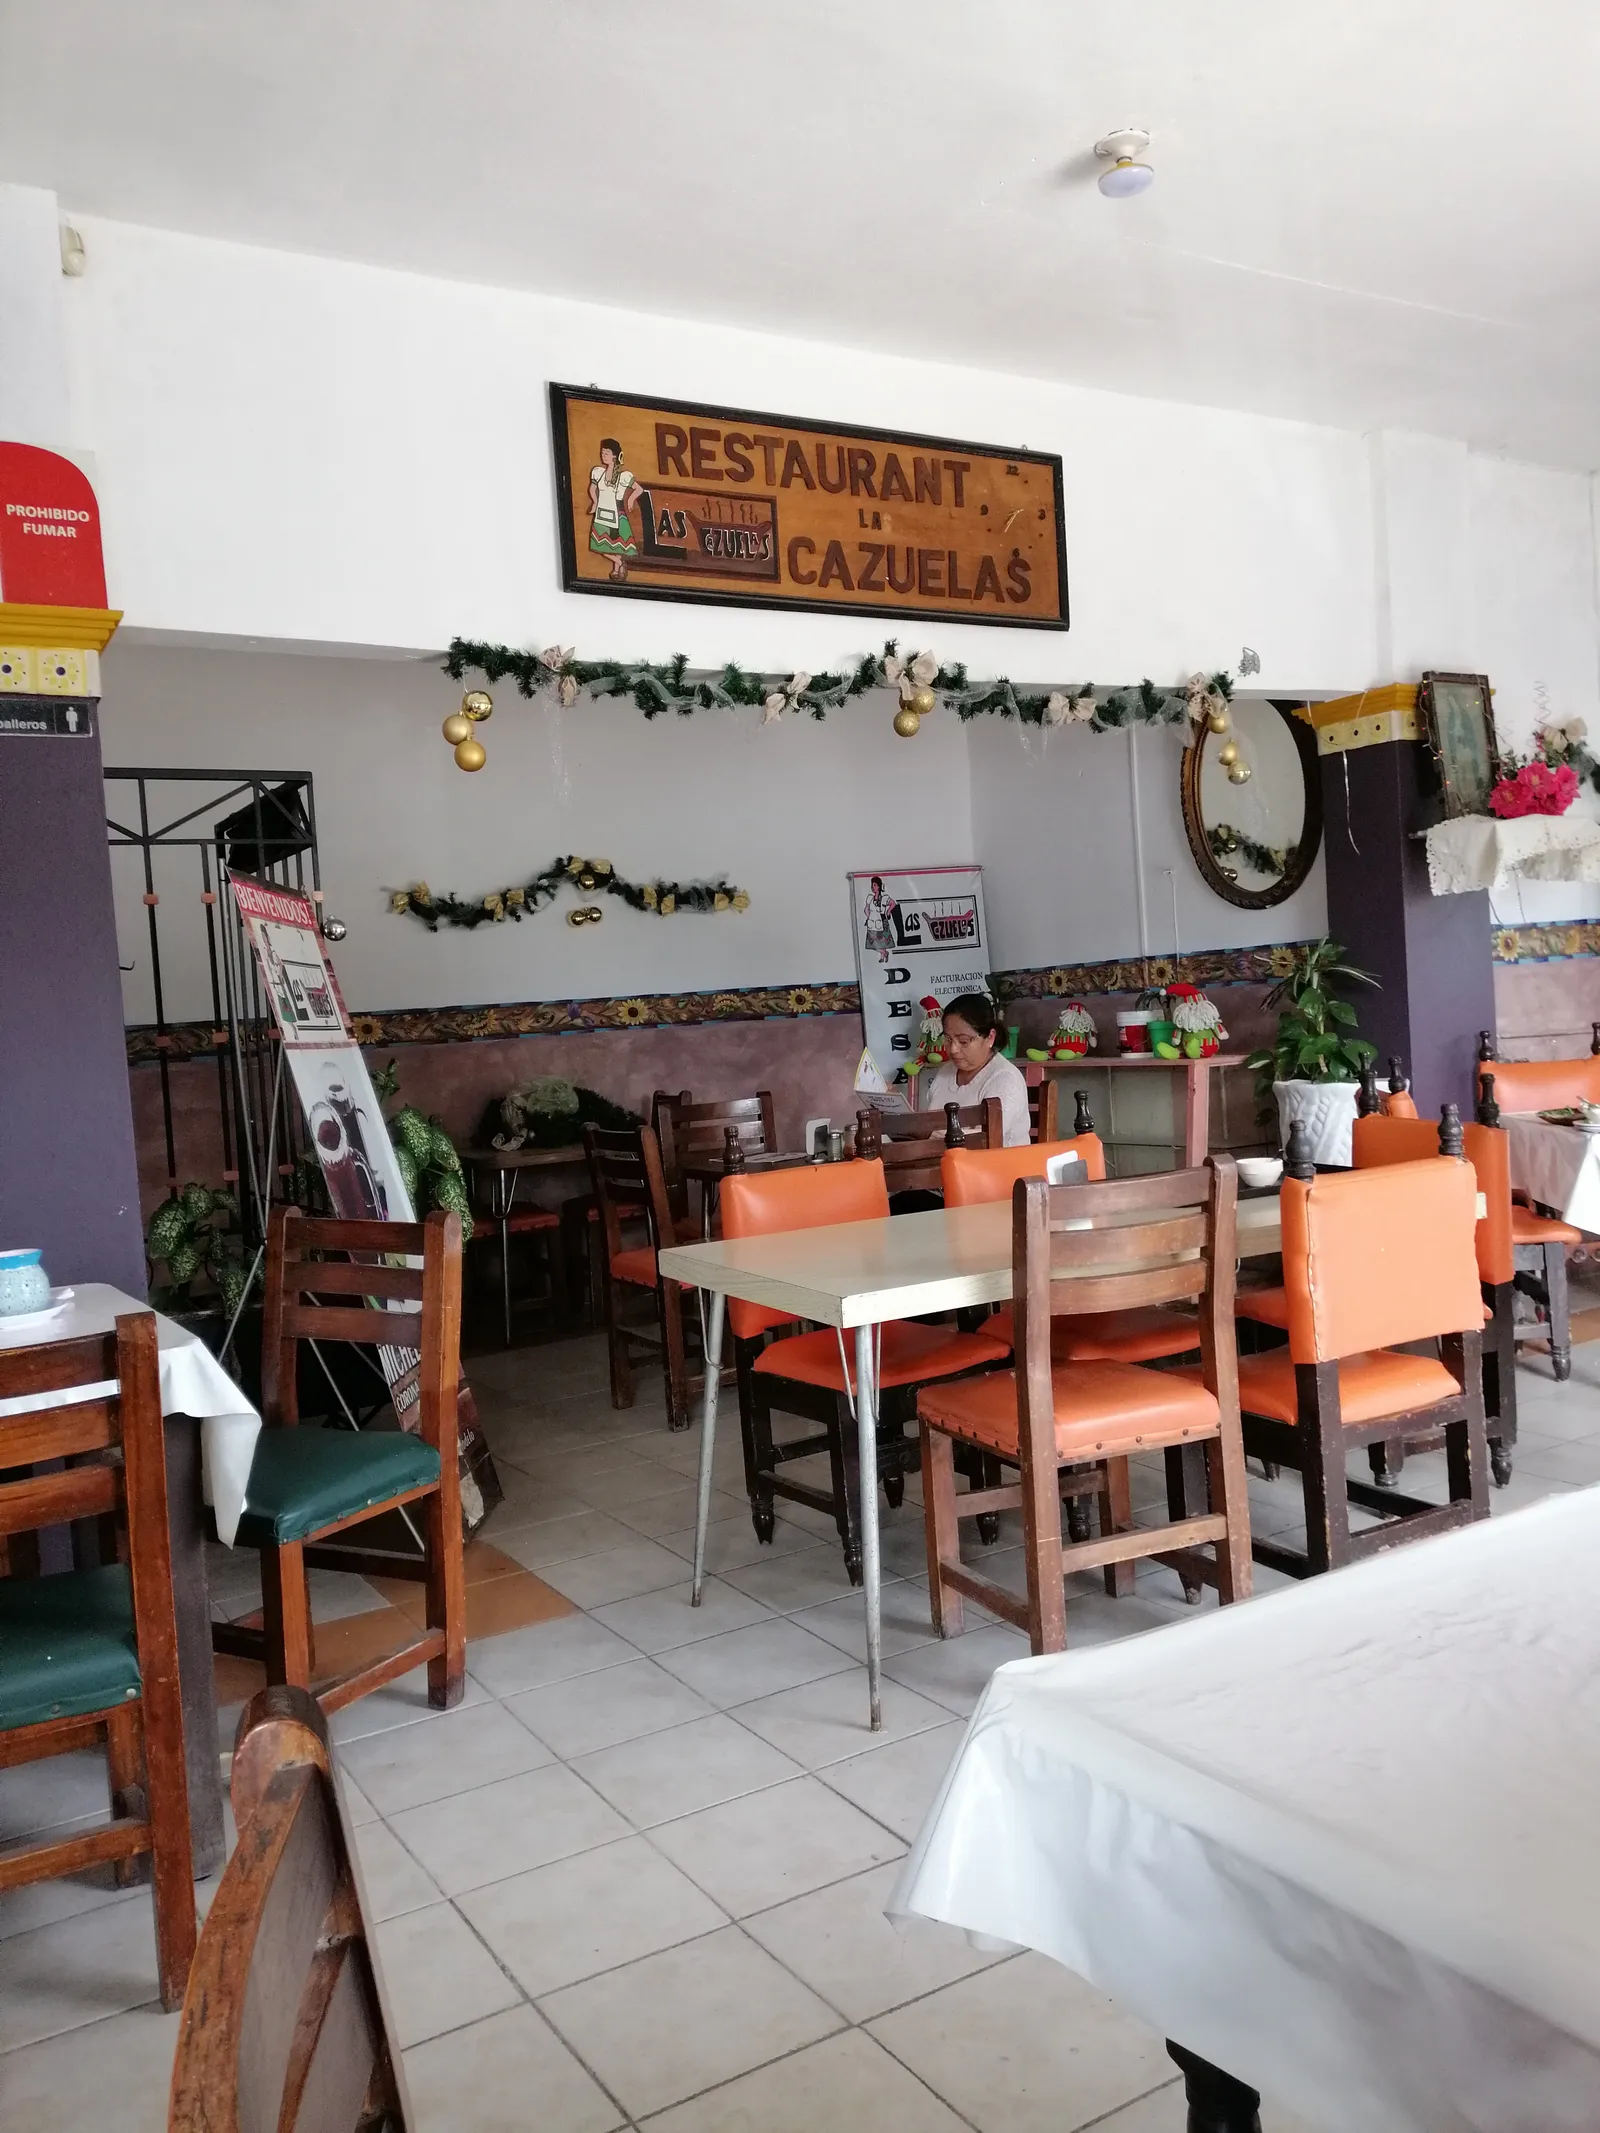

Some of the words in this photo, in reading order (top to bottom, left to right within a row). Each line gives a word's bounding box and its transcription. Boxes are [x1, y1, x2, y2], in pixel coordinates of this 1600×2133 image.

[655, 422, 971, 508] RESTAURANT
[1006, 464, 1019, 476] 12
[6, 503, 90, 522] PROHIBIDO
[1038, 508, 1047, 520] 3
[23, 522, 77, 538] FUMAR
[787, 536, 1032, 604] CAZUELAS
[234, 882, 314, 925] BIENVENIDOS!
[930, 972, 983, 984] FACTURACION
[934, 985, 982, 995] ELECTRONICA
